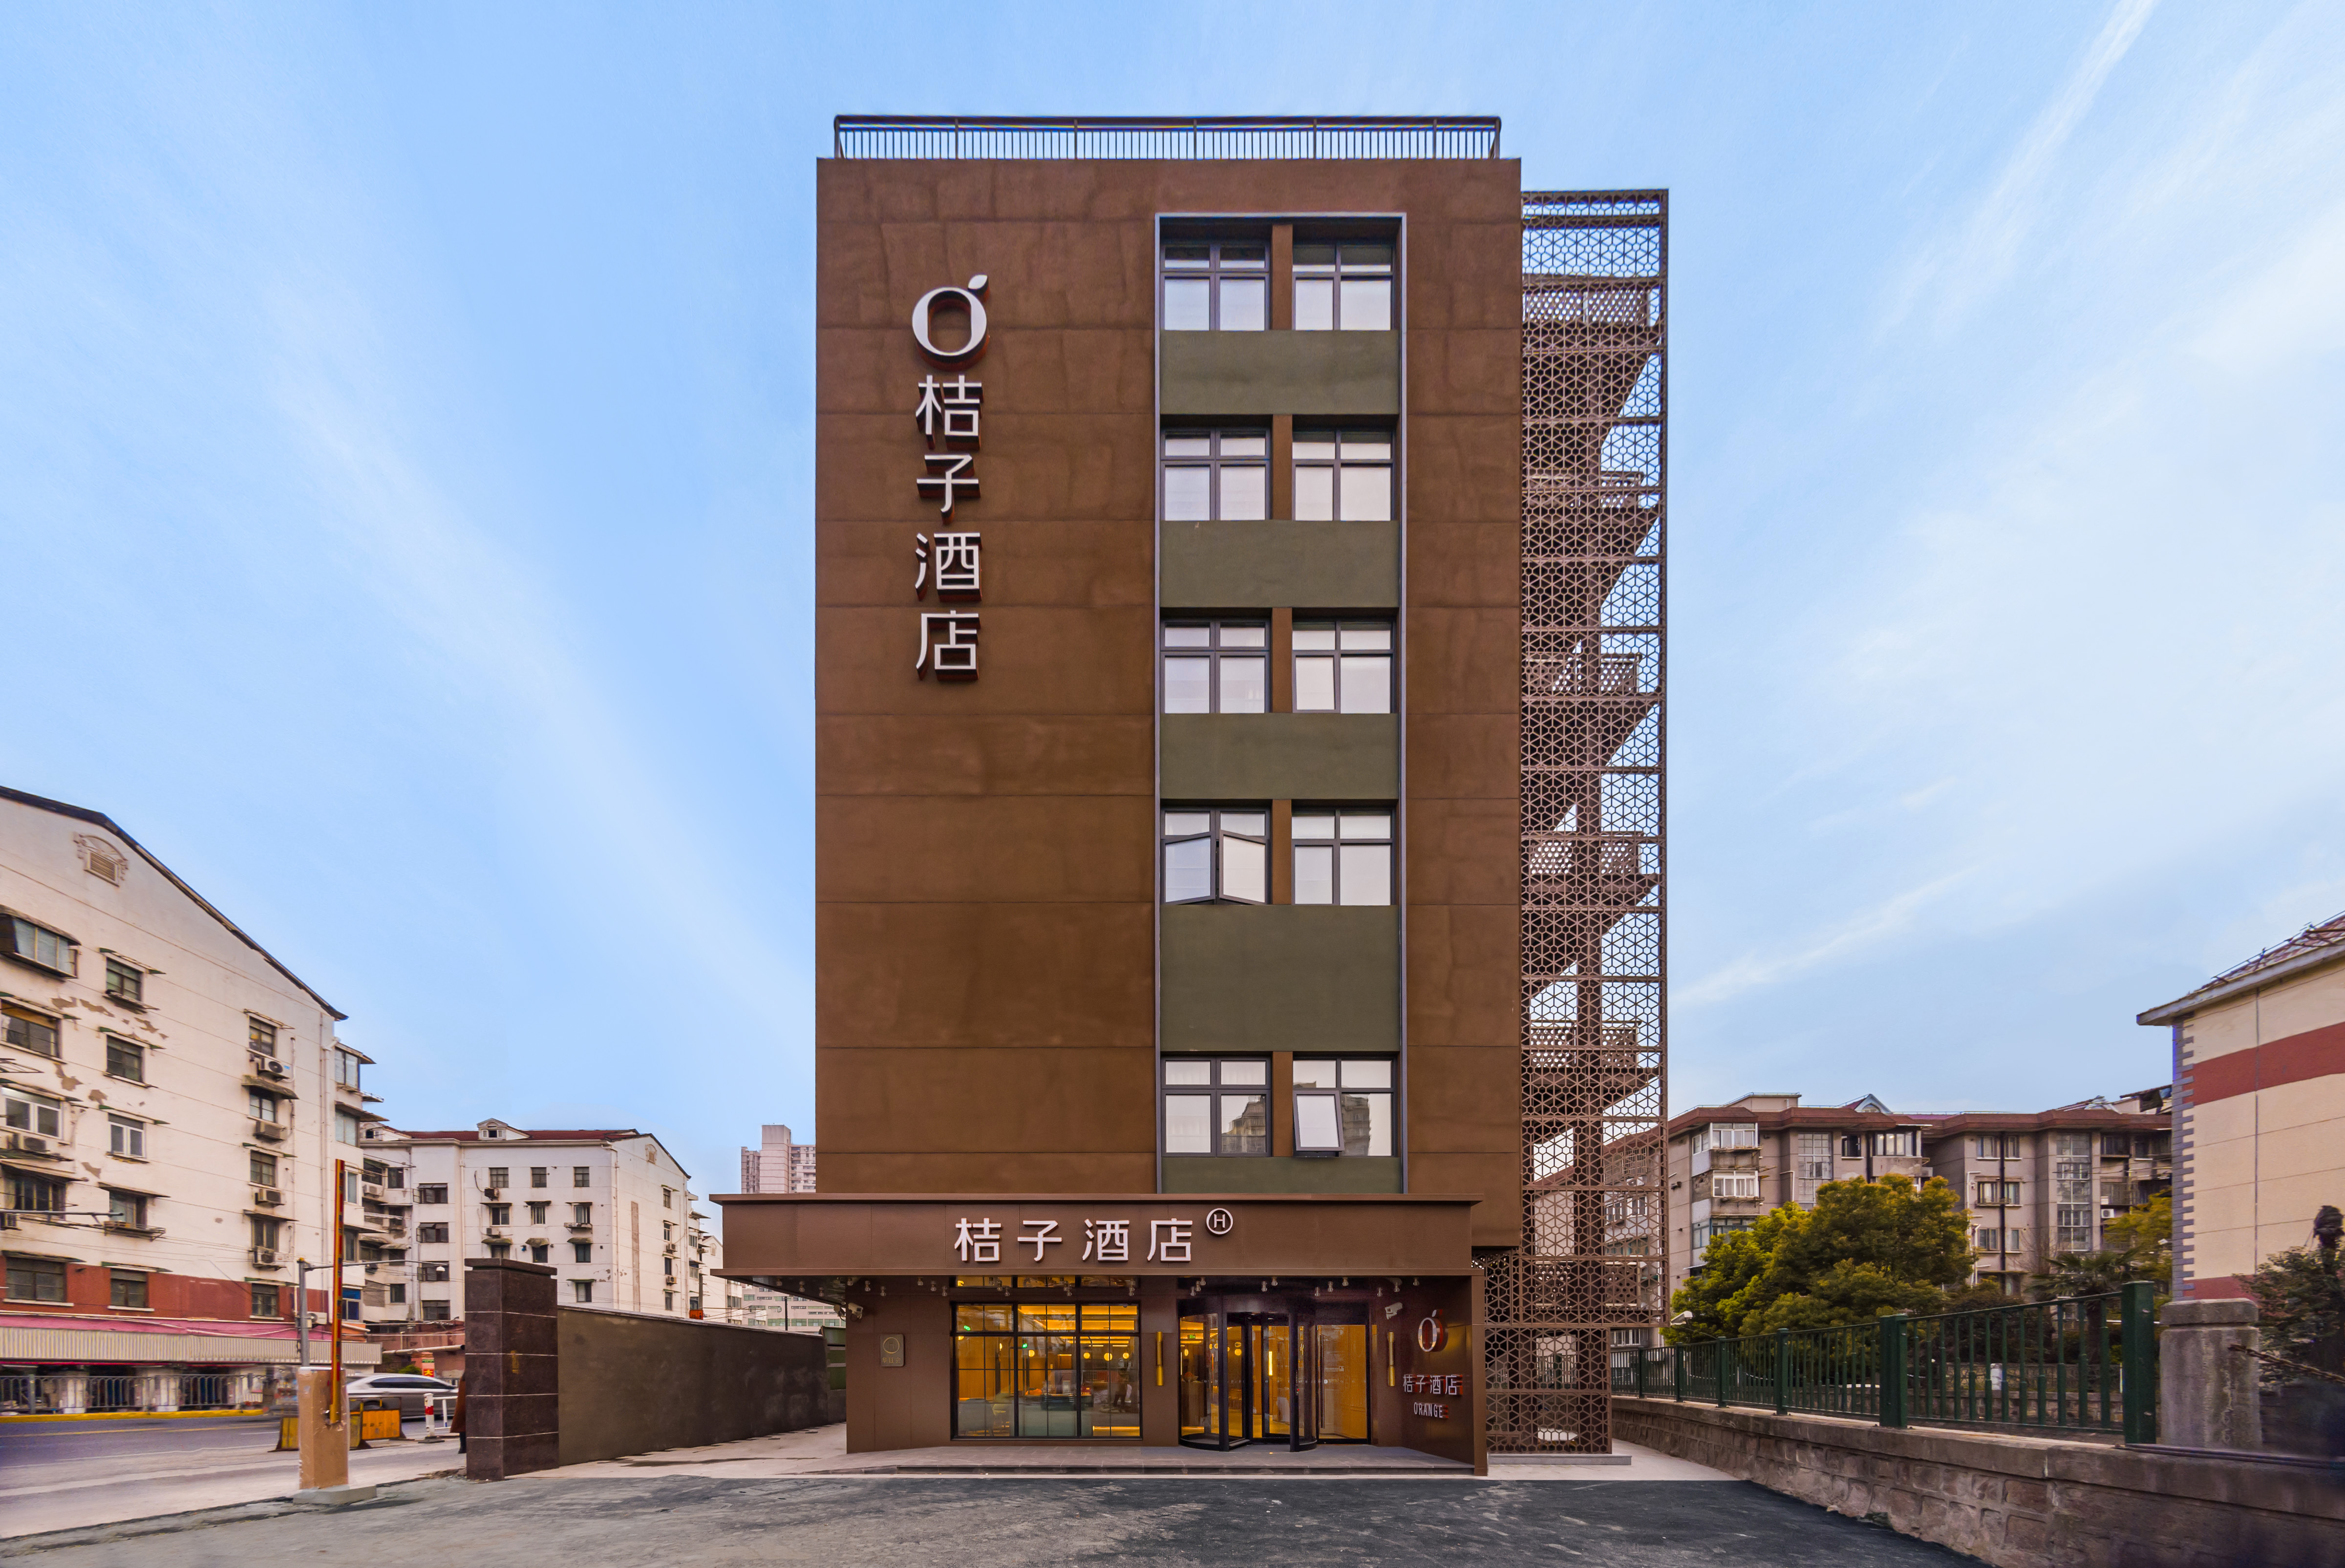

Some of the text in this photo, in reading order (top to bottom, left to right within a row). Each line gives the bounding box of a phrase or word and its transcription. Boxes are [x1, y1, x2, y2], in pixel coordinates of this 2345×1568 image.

[915, 375, 982, 671] 桔子酒店
[954, 1218, 1193, 1262] 桔子酒店
[1403, 1374, 1457, 1395] 桔子酒店
[1413, 1402, 1443, 1418] ORANGE
